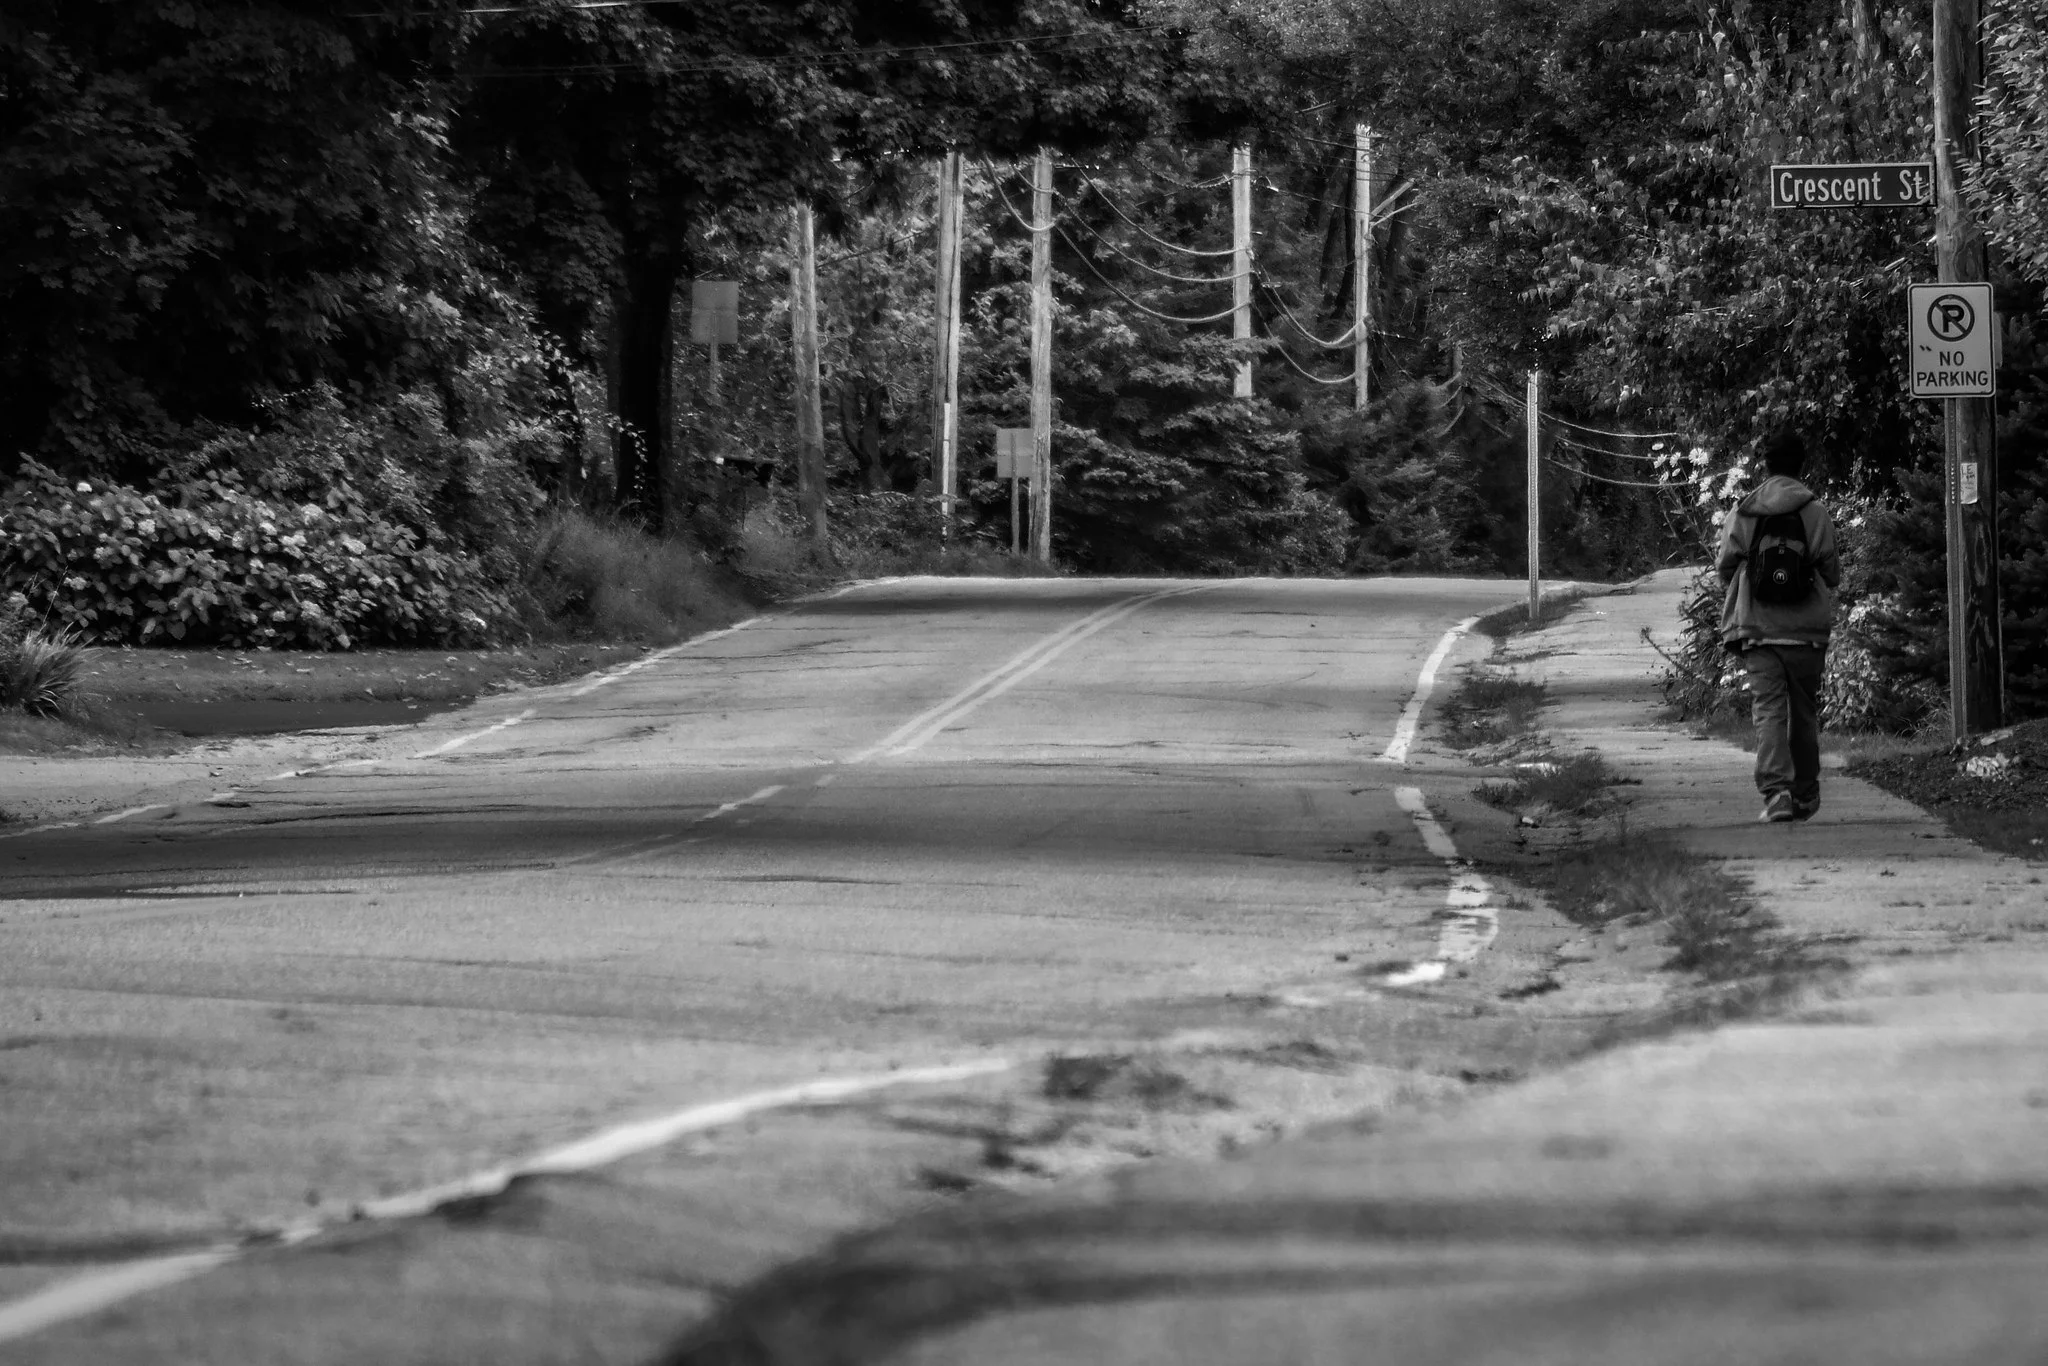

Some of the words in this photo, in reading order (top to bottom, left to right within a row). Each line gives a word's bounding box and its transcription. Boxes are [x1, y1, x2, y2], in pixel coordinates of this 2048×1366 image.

[1780, 171, 1882, 203] Crescent
[1899, 169, 1923, 200] St
[1940, 351, 1964, 366] NO
[1916, 371, 1988, 387] PARKING
